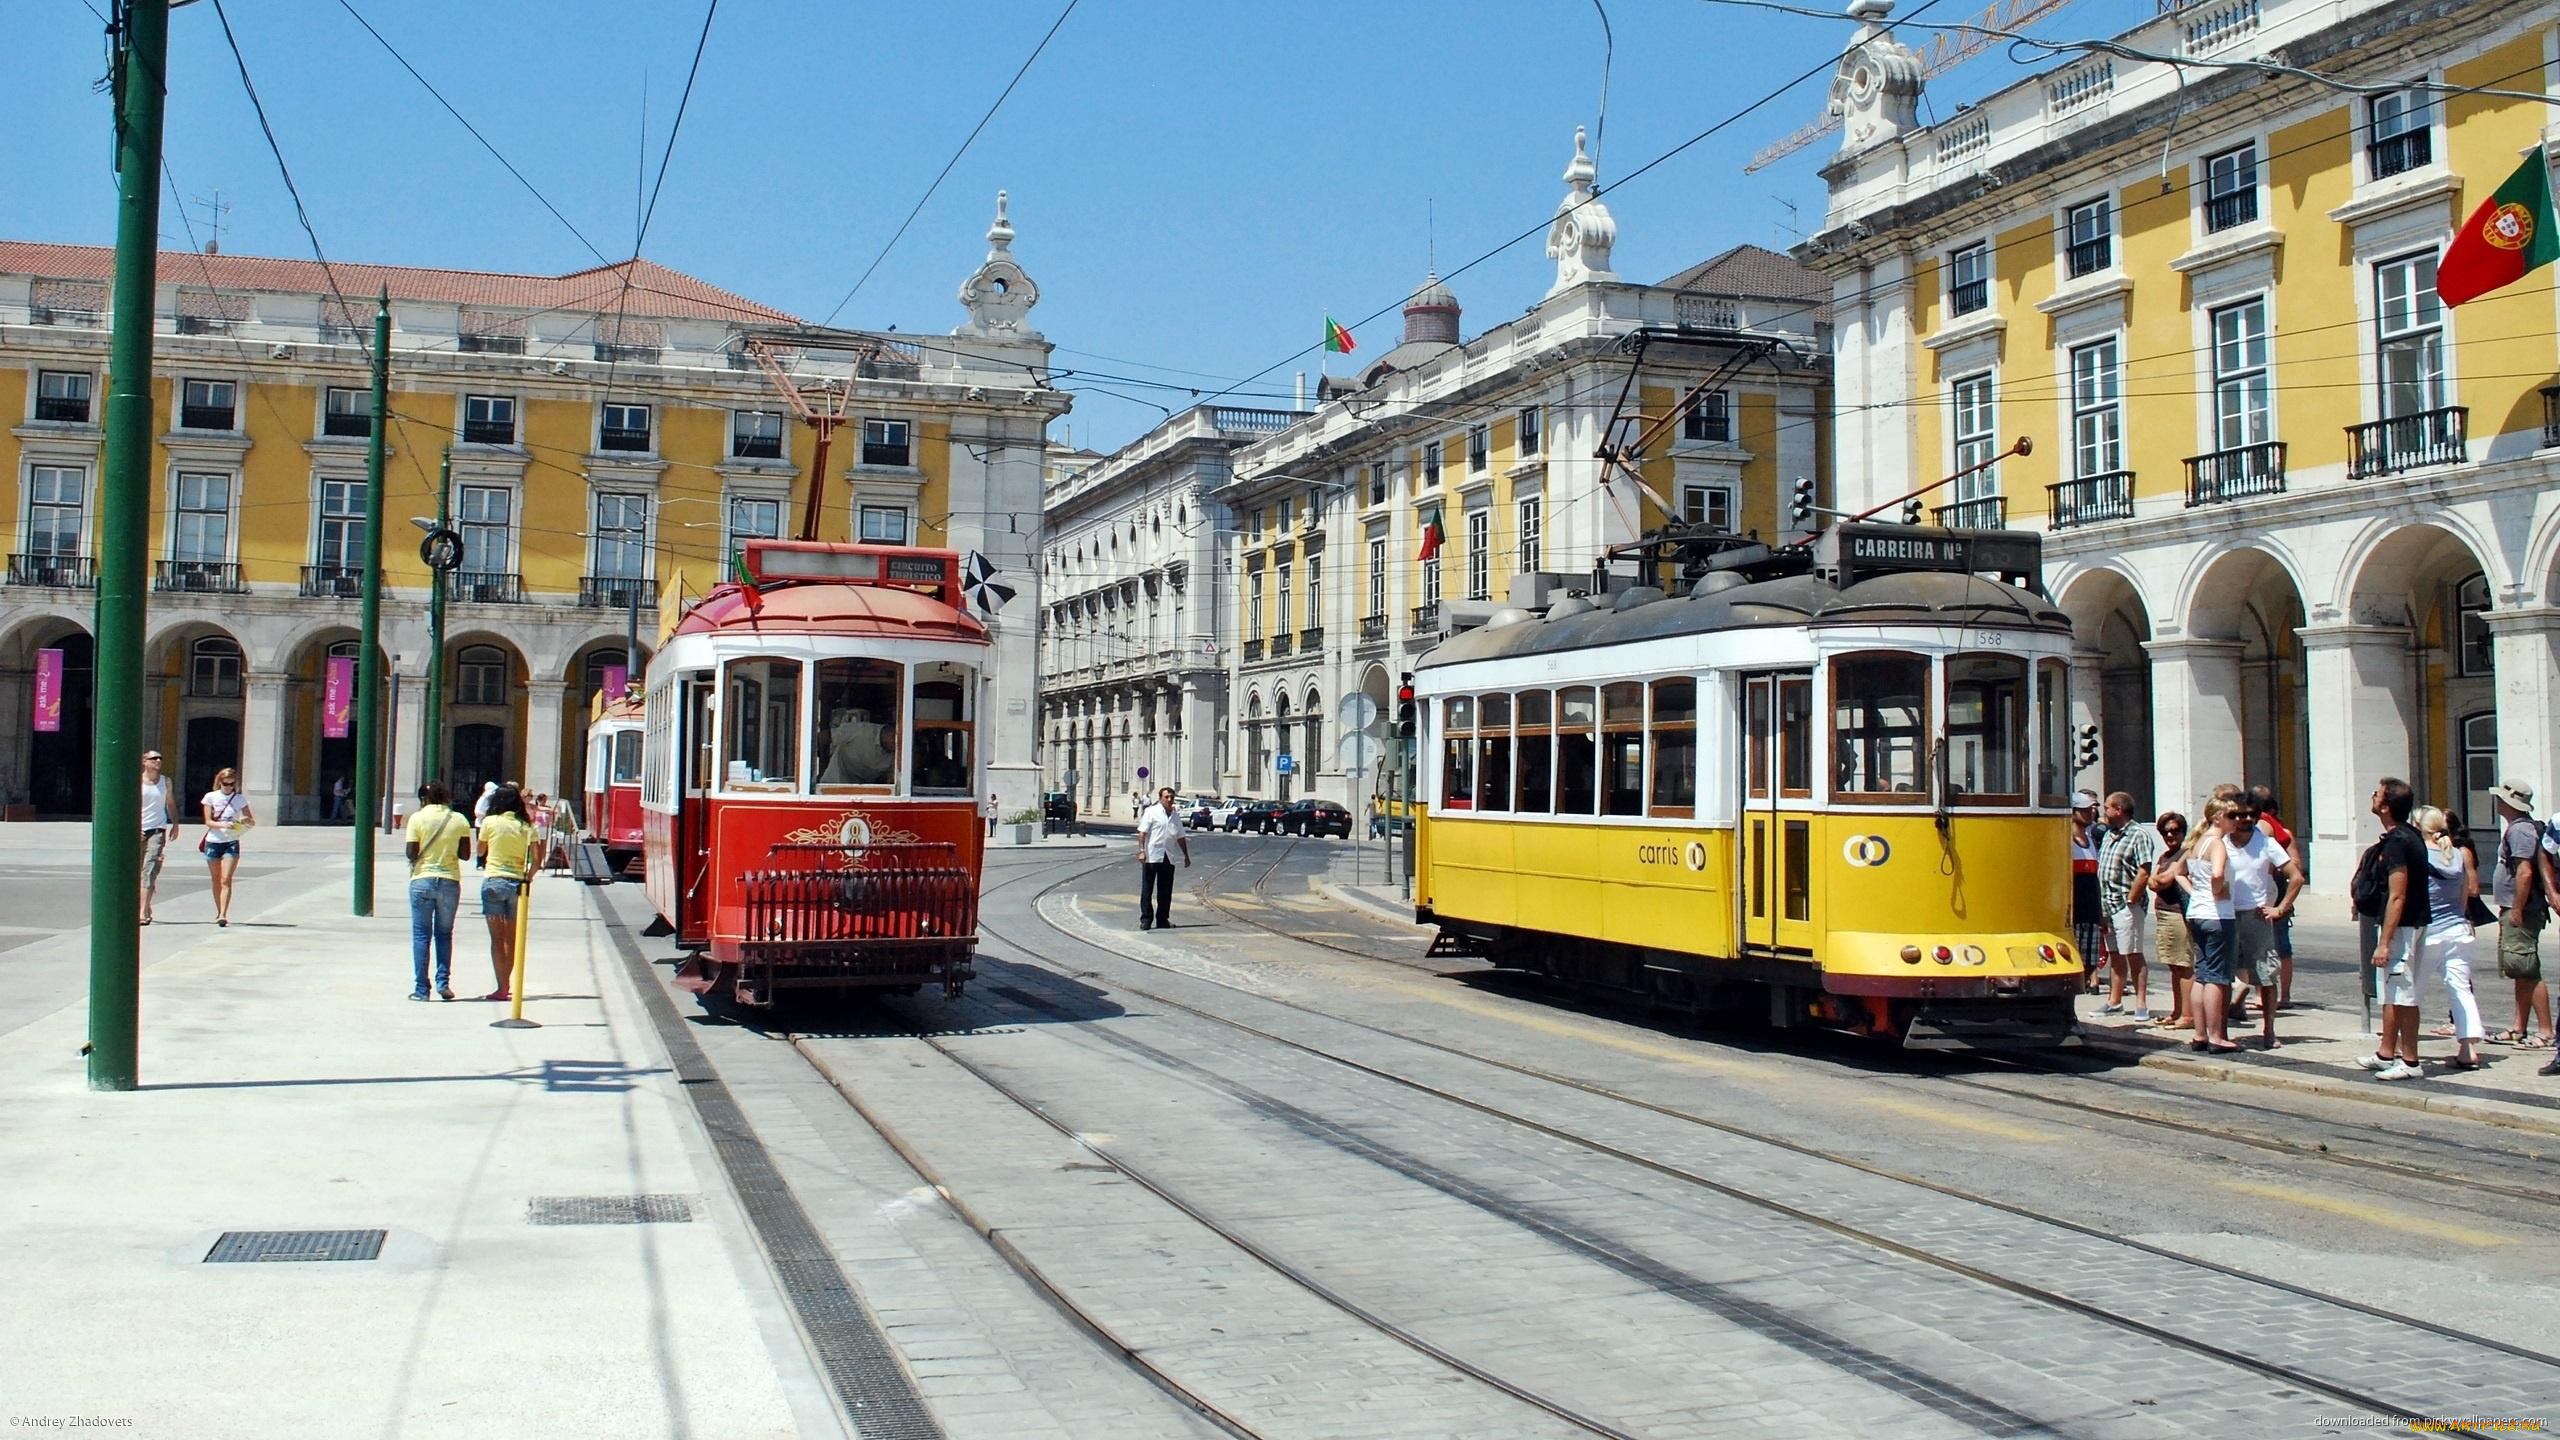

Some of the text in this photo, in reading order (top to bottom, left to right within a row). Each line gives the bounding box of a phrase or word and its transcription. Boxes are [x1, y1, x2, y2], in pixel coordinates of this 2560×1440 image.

[1855, 538, 1935, 560] CARREIRA
[1943, 542, 1963, 561] Nº
[890, 561, 938, 571] CIRCUITO
[1980, 631, 2002, 646] 568
[1280, 757, 1289, 769] P
[1639, 838, 1678, 865] carris
